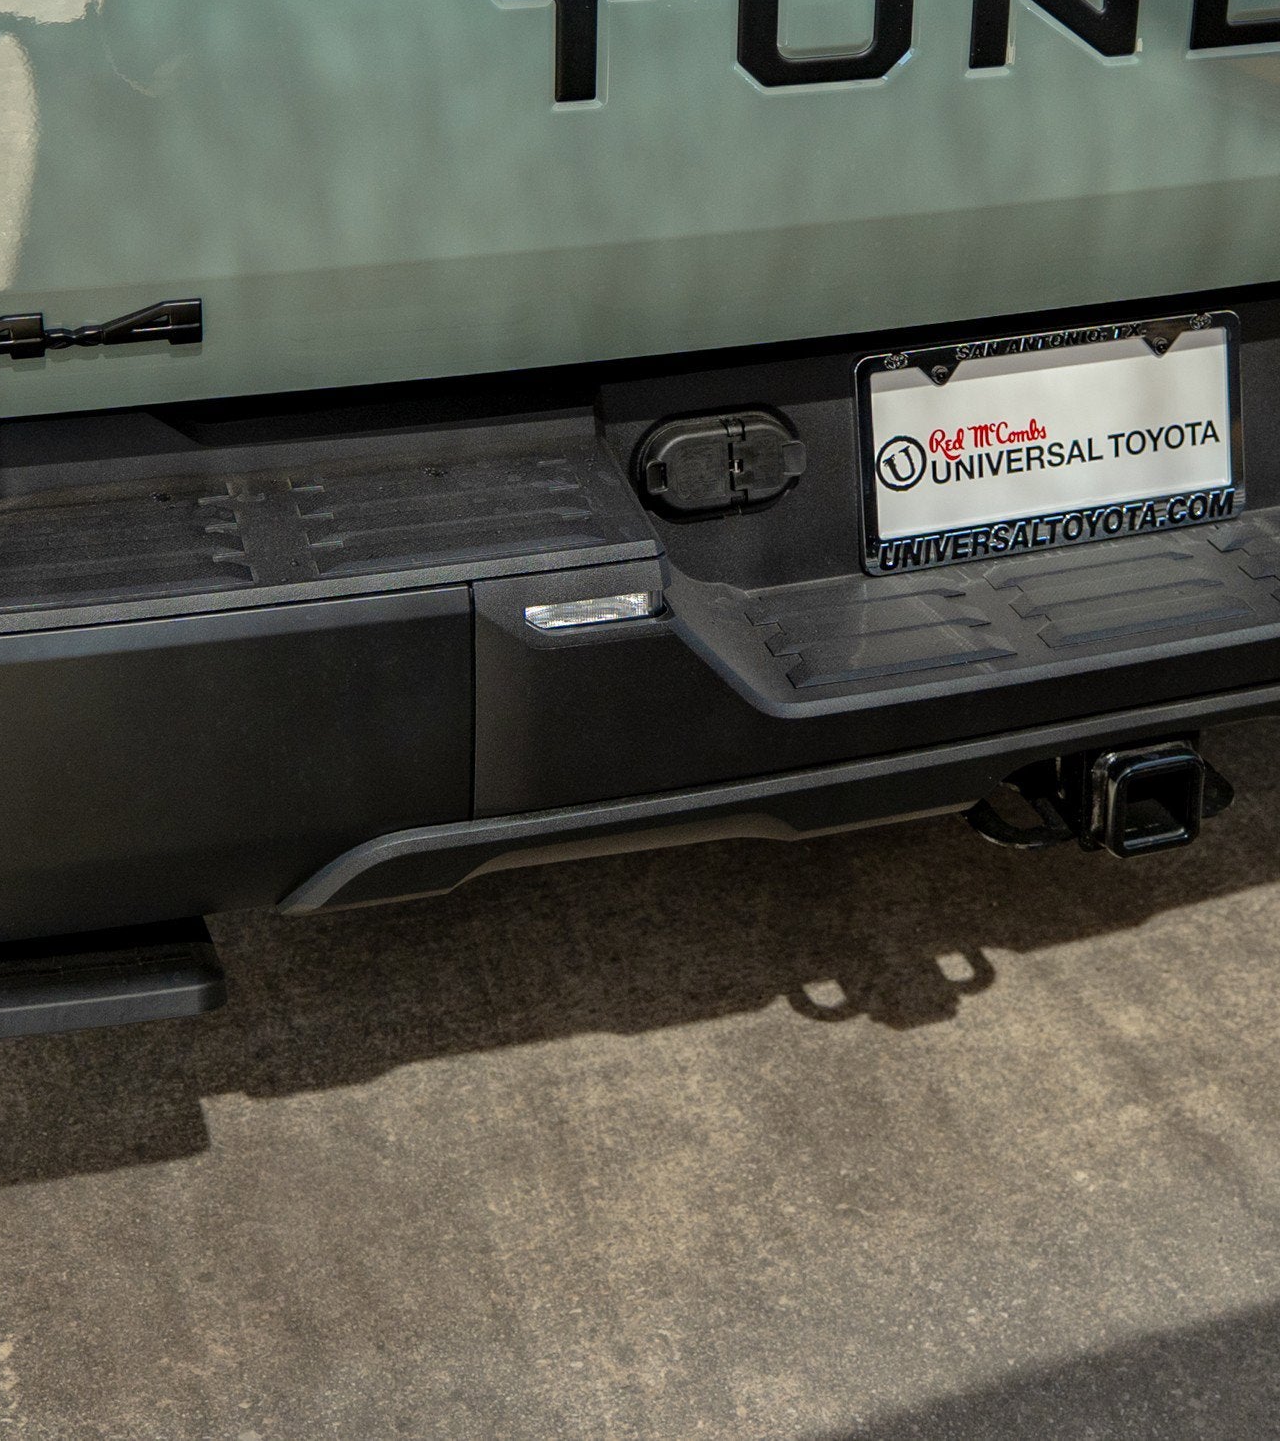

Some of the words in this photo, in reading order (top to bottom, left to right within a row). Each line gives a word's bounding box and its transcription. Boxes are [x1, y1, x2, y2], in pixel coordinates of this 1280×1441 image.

[956, 340, 998, 360] SAN
[928, 428, 965, 462] Red
[967, 417, 1048, 450] McCombs
[932, 438, 1104, 484] UNIVERSAL
[1107, 420, 1221, 459] TOYOTA
[880, 489, 1235, 570] UNIVERSALTOYOTA.COM
